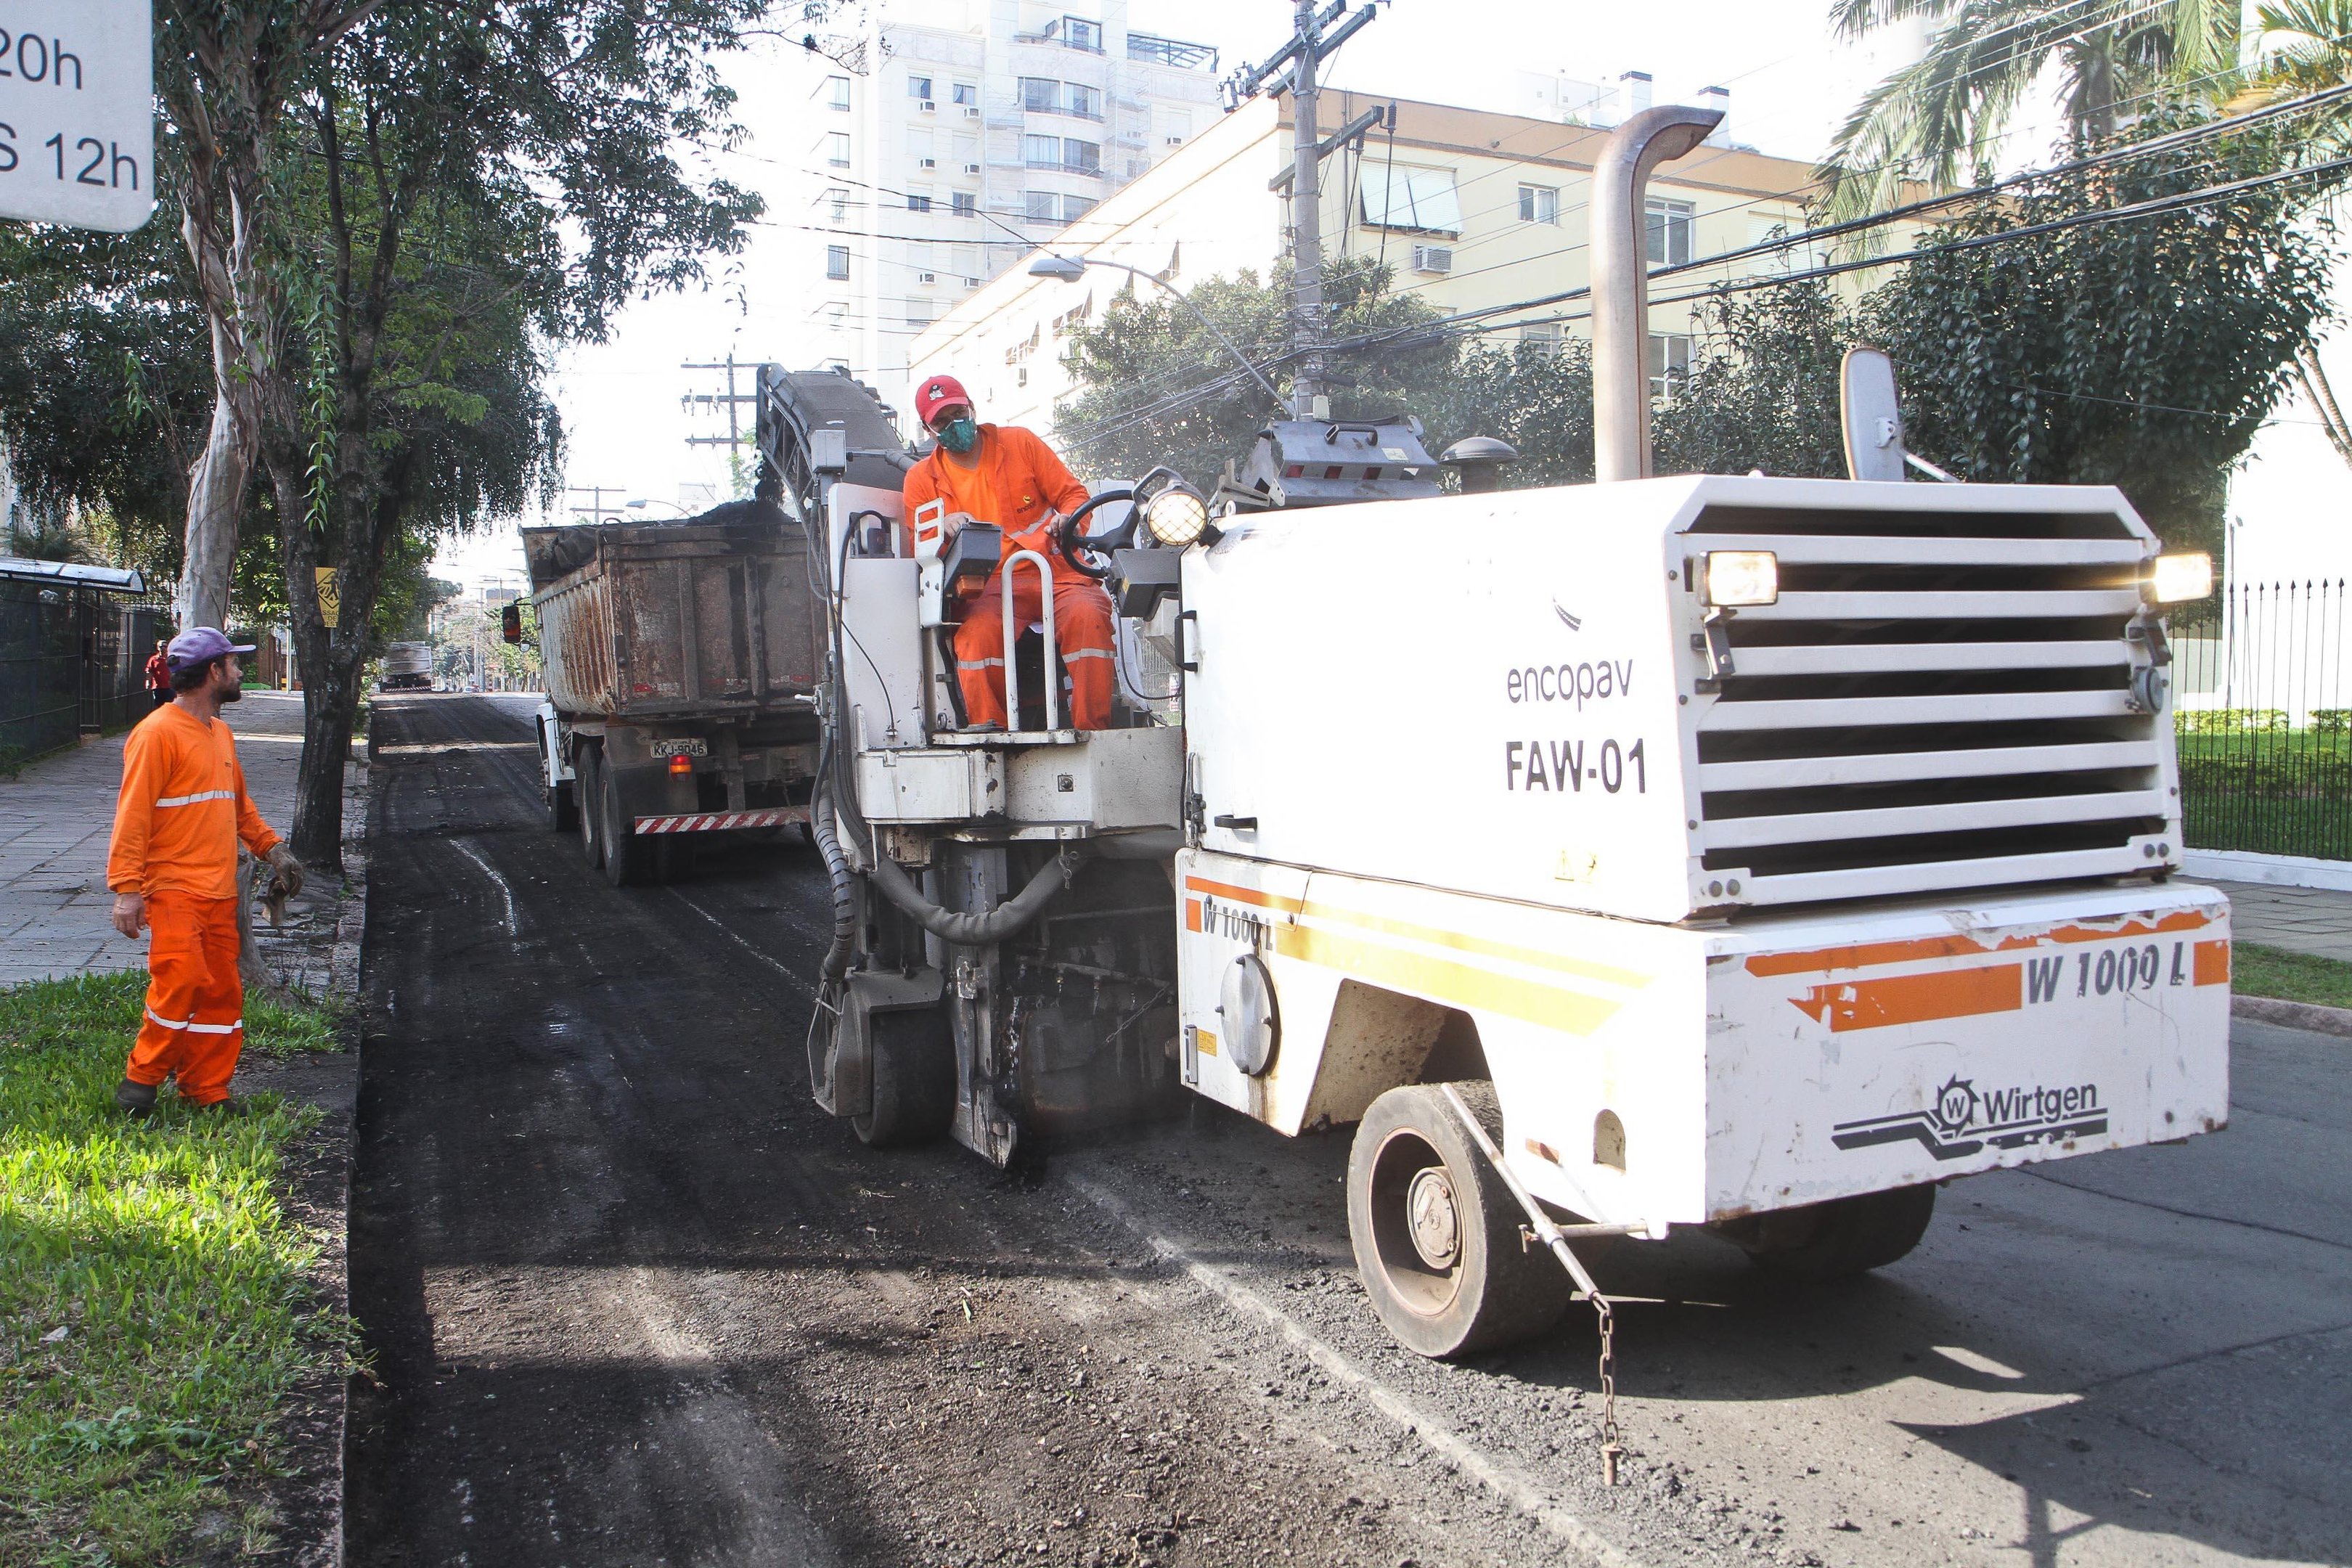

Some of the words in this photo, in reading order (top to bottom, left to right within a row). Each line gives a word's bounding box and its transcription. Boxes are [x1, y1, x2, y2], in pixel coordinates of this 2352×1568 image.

[45, 133, 138, 190] 12h
[1508, 659, 1633, 712] encopav
[654, 744, 704, 755] KKJ-9046
[1506, 738, 1646, 793] FAW-01
[1204, 900, 1217, 934] W
[1222, 906, 1262, 947] 1000
[2029, 955, 2064, 1004] W
[2077, 944, 2160, 998] 1000
[2170, 942, 2186, 986] L
[1946, 1096, 1965, 1119] W
[1983, 1083, 2096, 1124] Wirtgen
